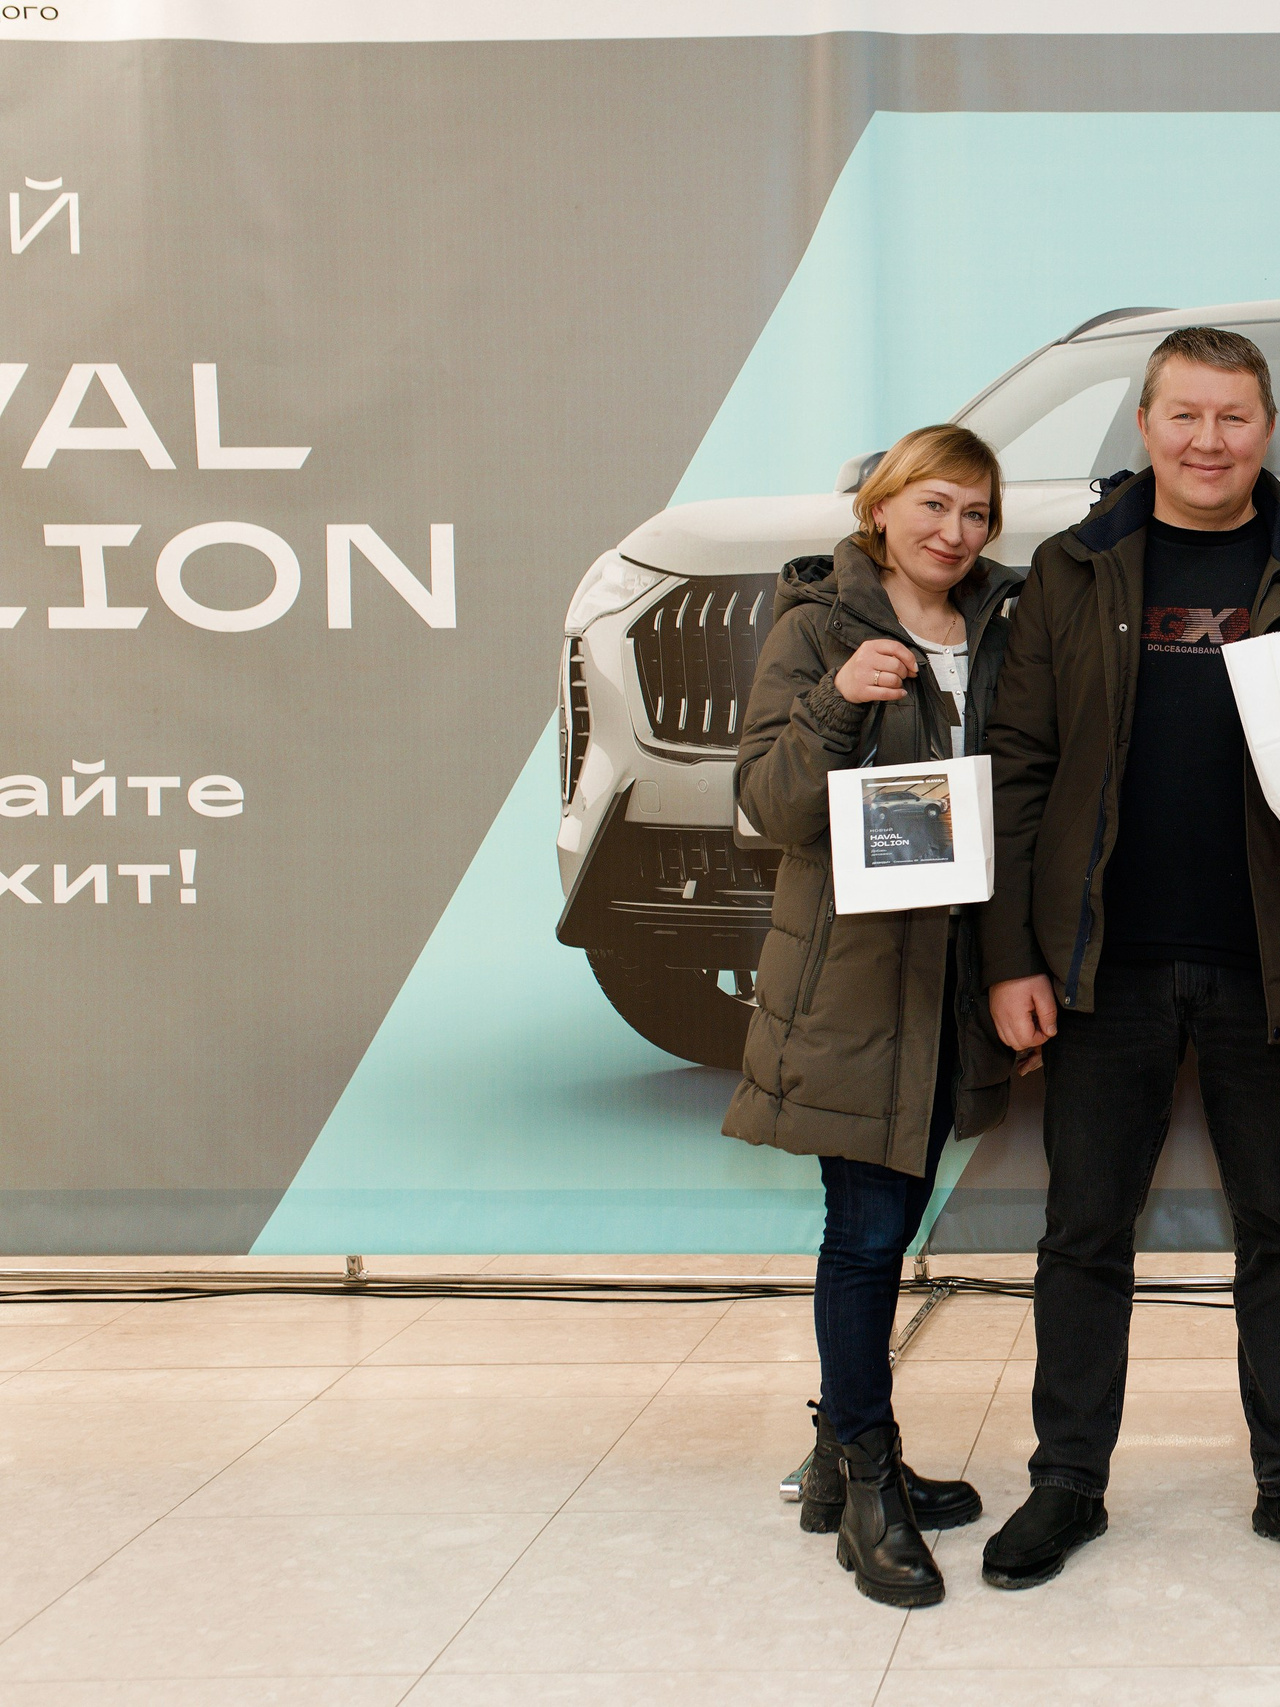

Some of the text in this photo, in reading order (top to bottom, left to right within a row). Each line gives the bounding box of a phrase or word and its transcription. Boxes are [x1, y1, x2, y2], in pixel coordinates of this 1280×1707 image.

[0, 521, 457, 632] ION
[1147, 643, 1220, 655] DOLCE&GABBANA
[870, 839, 910, 848] JOLION
